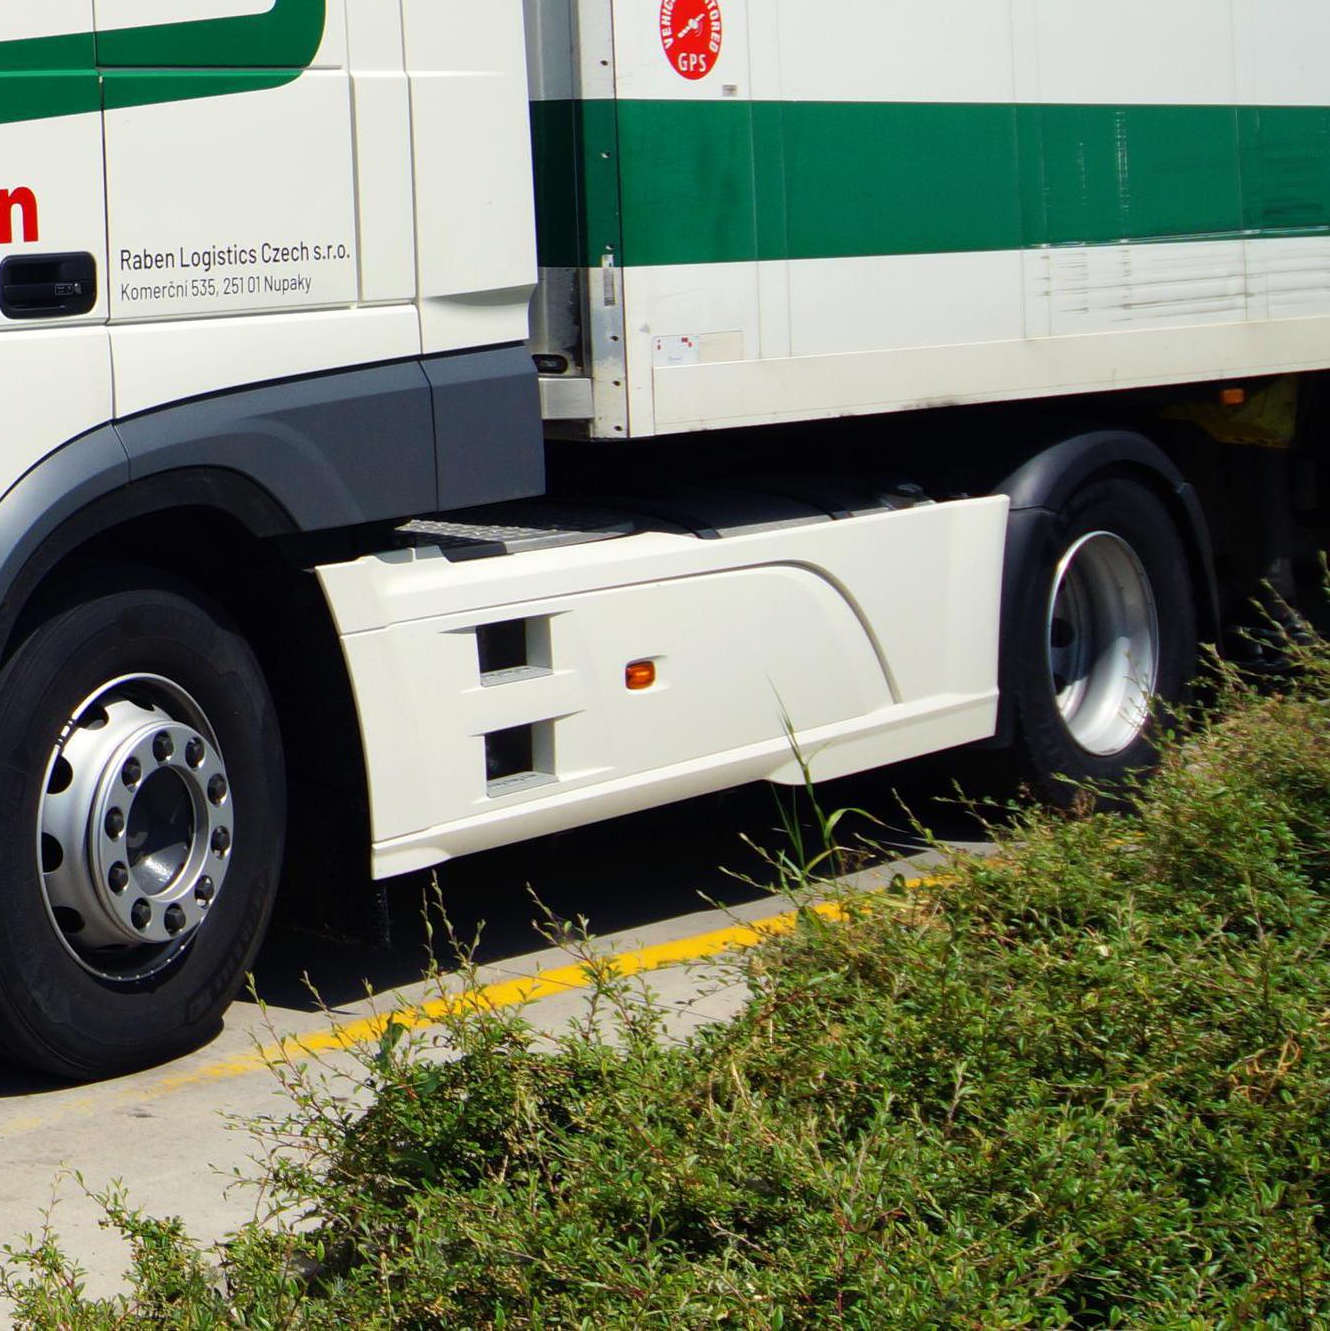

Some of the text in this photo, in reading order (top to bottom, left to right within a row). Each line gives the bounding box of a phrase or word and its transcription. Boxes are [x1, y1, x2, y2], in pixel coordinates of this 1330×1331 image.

[677, 51, 708, 73] GPS
[120, 241, 352, 272] Raben Logistics Czech s.r.o.
[191, 278, 220, 298] 535,
[223, 276, 245, 296] 251
[247, 276, 262, 294] 01
[264, 273, 313, 295] Nupaky
